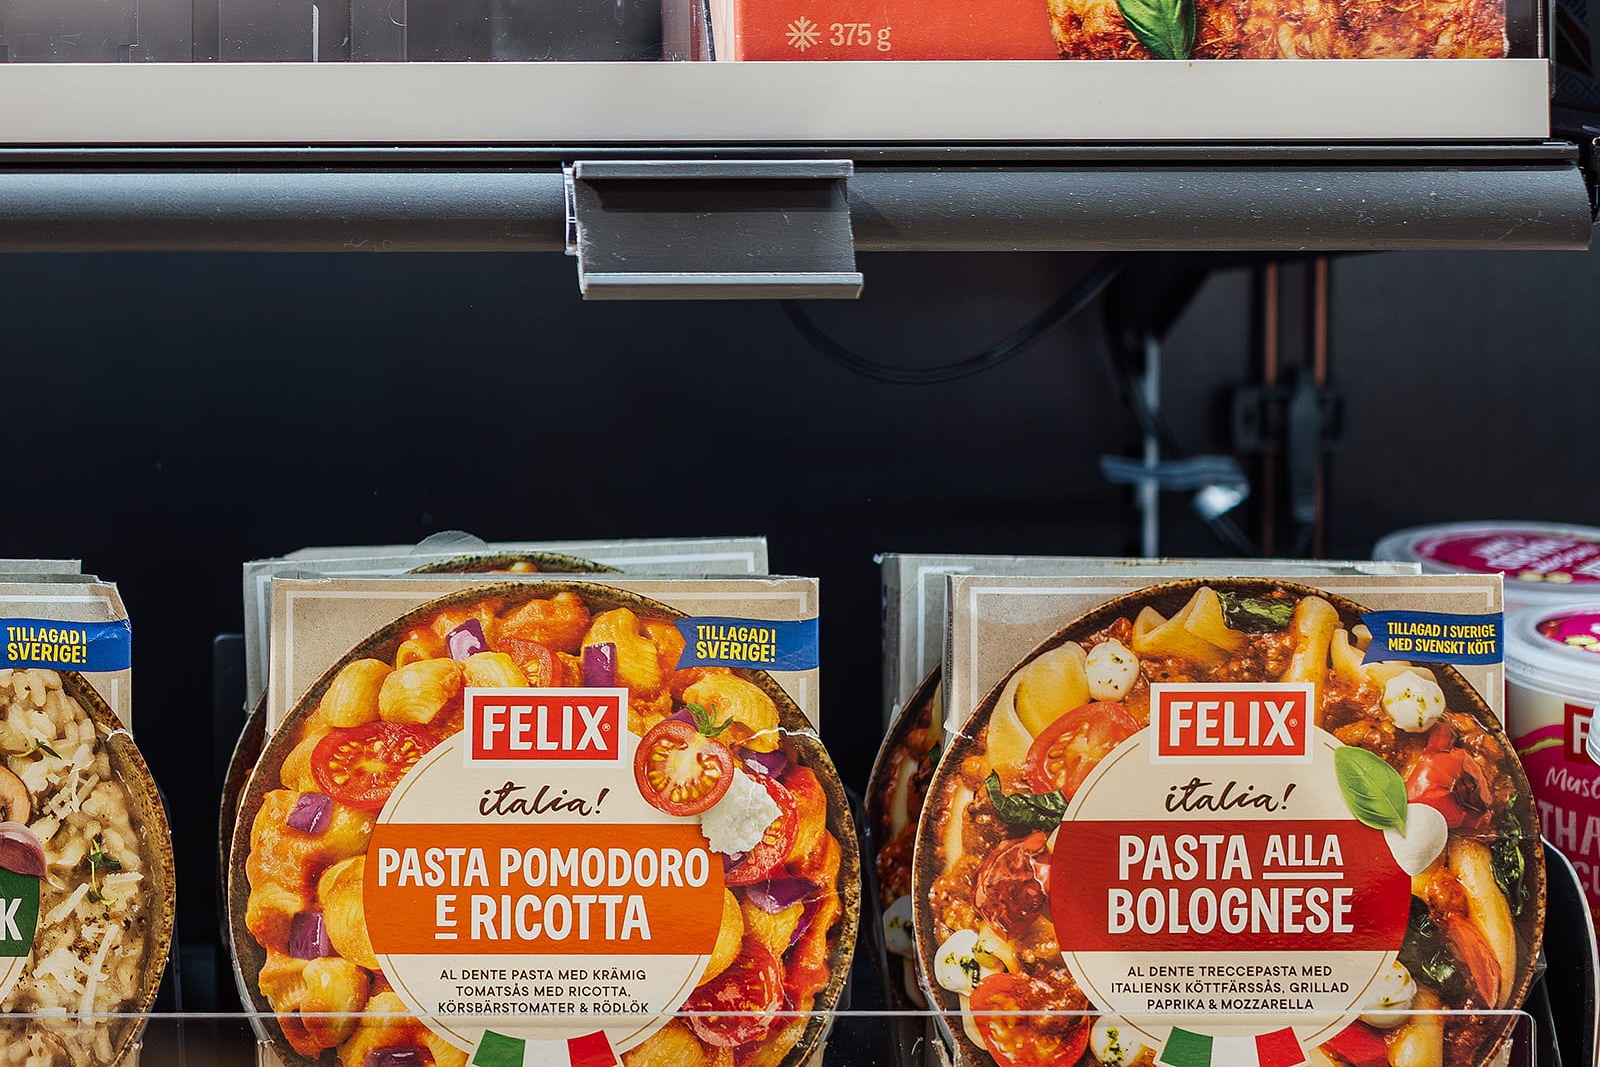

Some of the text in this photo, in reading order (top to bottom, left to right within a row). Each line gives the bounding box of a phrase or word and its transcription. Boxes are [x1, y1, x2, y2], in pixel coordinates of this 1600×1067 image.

[829, 23, 892, 52] 375 g
[7, 626, 81, 645] TILLAGAD
[696, 625, 769, 643] TILLAGAD
[1387, 622, 1496, 639] TILLAGAD I SVERIGE
[7, 642, 87, 664] SVERIGE!
[696, 641, 776, 663] SVERIGE!
[1388, 637, 1496, 655] MED SVENSKT KÖTT
[483, 705, 609, 751] FELIX
[1169, 701, 1296, 747] FELIX
[478, 781, 610, 817] italia!
[1165, 777, 1297, 813] italia!
[378, 847, 710, 888] PASTA POMODORO
[1118, 834, 1344, 881] PASTA ALLA
[435, 894, 652, 941] E RICOTTA
[1108, 887, 1354, 934] BOLOGNESE
[440, 967, 646, 980] AL DENTE PASTA MED KRÄMIG
[1127, 966, 1332, 977] AL DENTE TRECCEPASTA MED
[455, 983, 631, 998] TOMATSÅS MED RICOTTA,
[1111, 979, 1349, 994] ITALIENSK KÖTTFÄRSSÅS, GRILLAD
[438, 999, 649, 1013] KÖRSBÄRSTOMATER & RÖDLÖK
[1147, 998, 1313, 1010] PAPRIKA & MOZZARELLA
